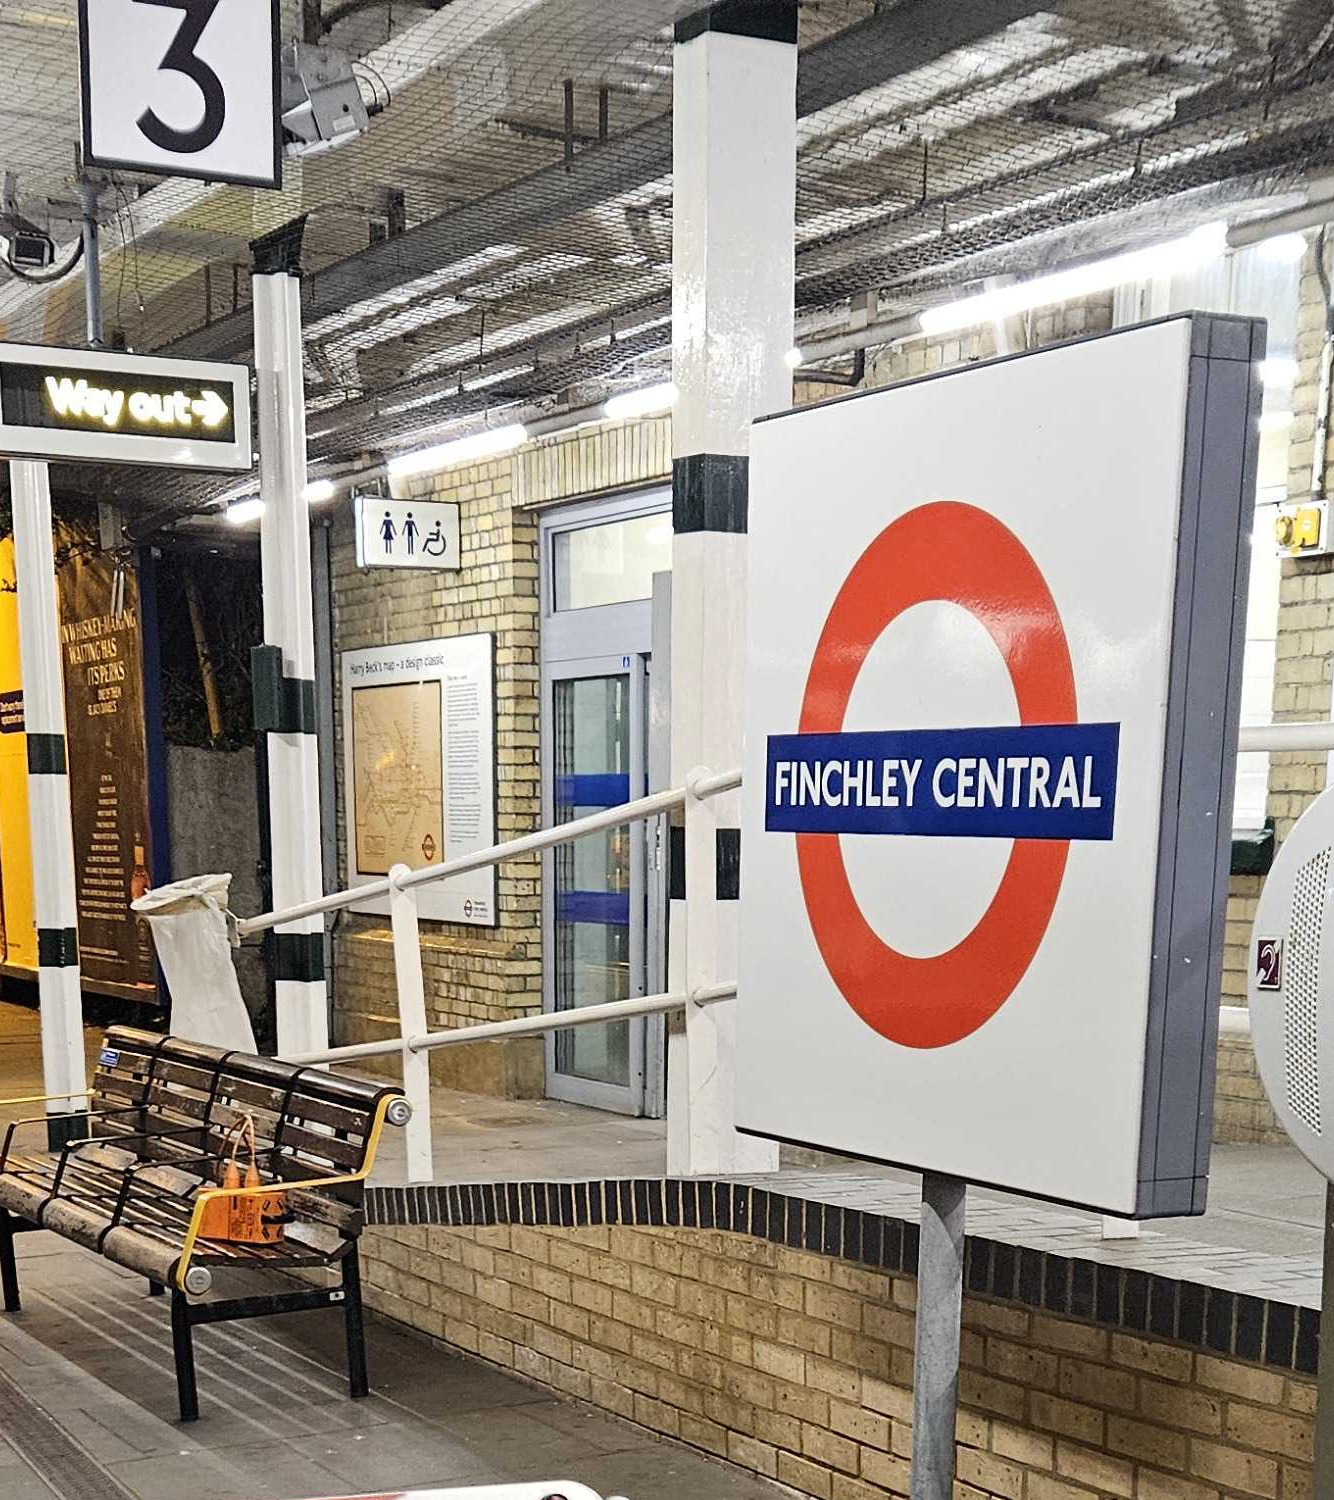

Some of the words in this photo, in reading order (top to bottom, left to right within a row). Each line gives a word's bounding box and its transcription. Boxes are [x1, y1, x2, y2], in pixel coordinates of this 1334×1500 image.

[132, 0, 225, 153] 3
[44, 376, 125, 427] Way
[128, 389, 193, 426] out
[774, 758, 923, 807] FINCHLEY
[932, 755, 1102, 808] CENTRAL
